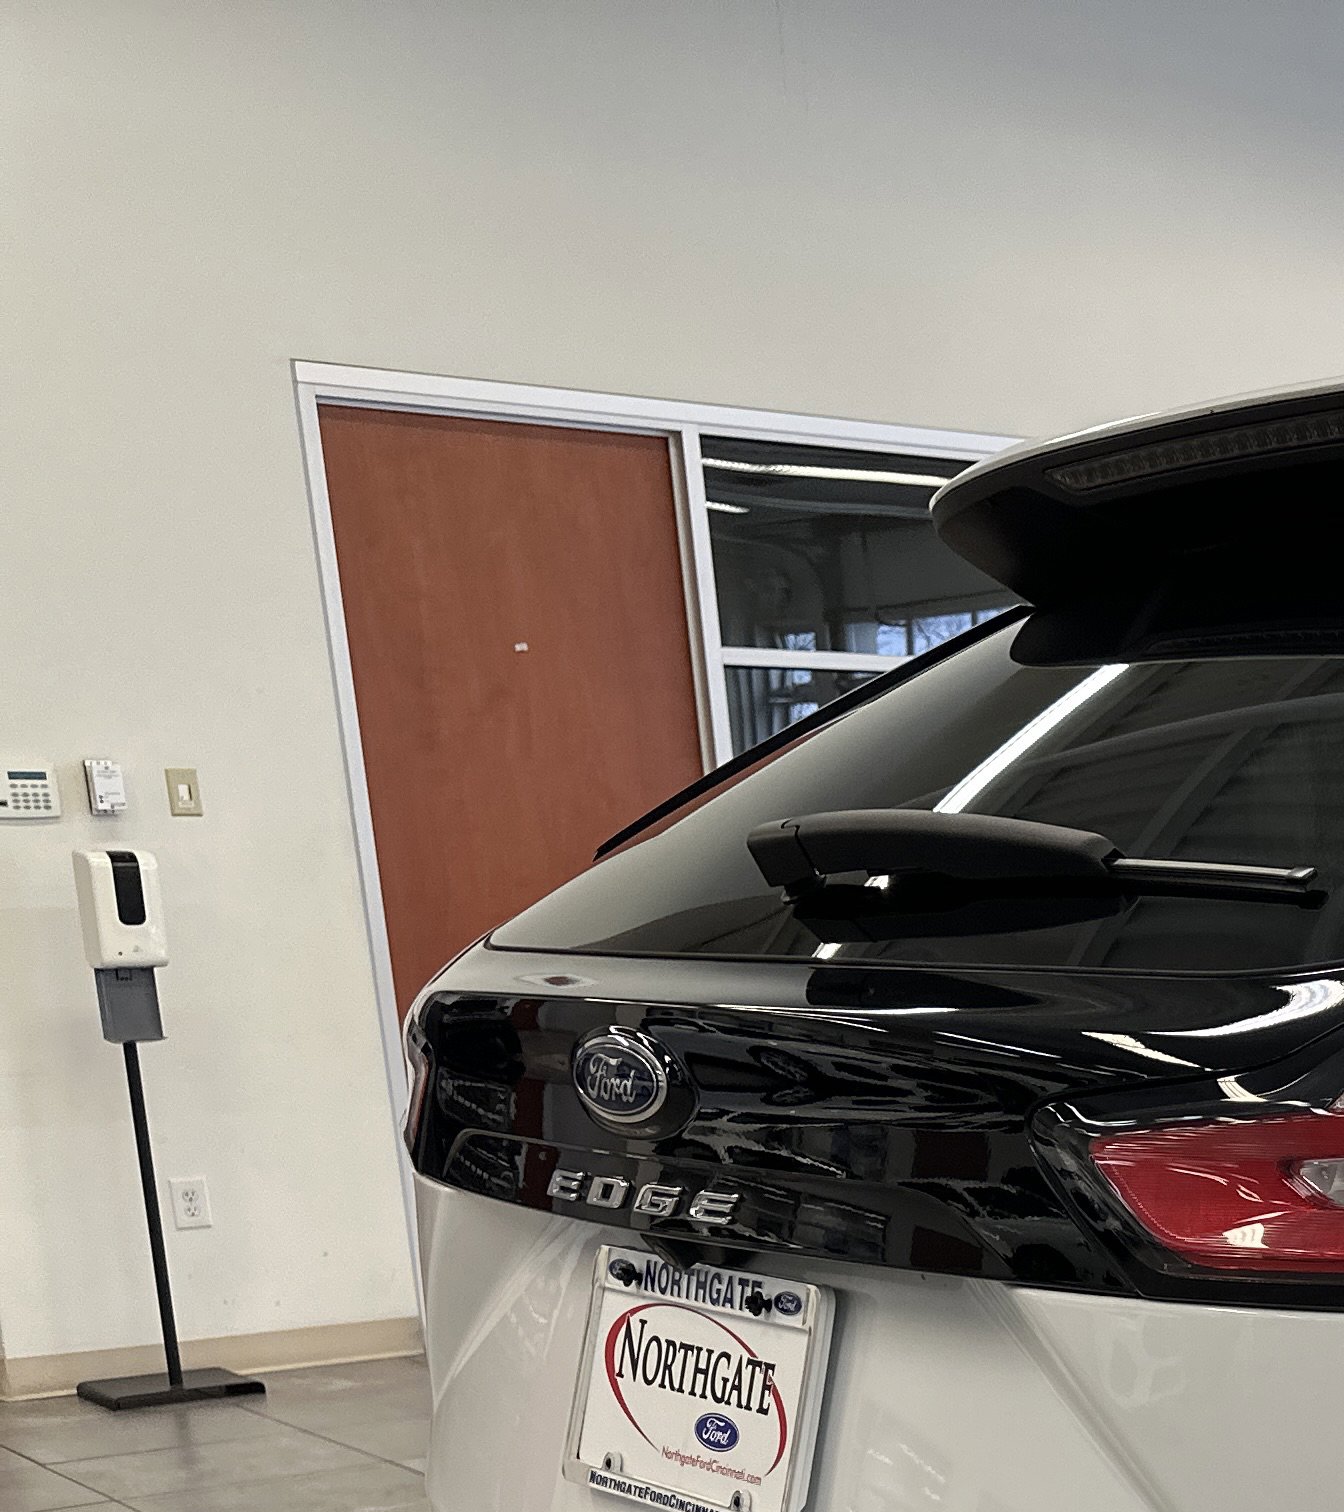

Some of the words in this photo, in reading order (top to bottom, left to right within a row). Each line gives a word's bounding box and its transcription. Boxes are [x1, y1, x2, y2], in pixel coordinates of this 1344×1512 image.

[587, 1053, 638, 1103] Ford
[547, 1168, 741, 1226] EDGE
[616, 1314, 776, 1416] NORTHGATE
